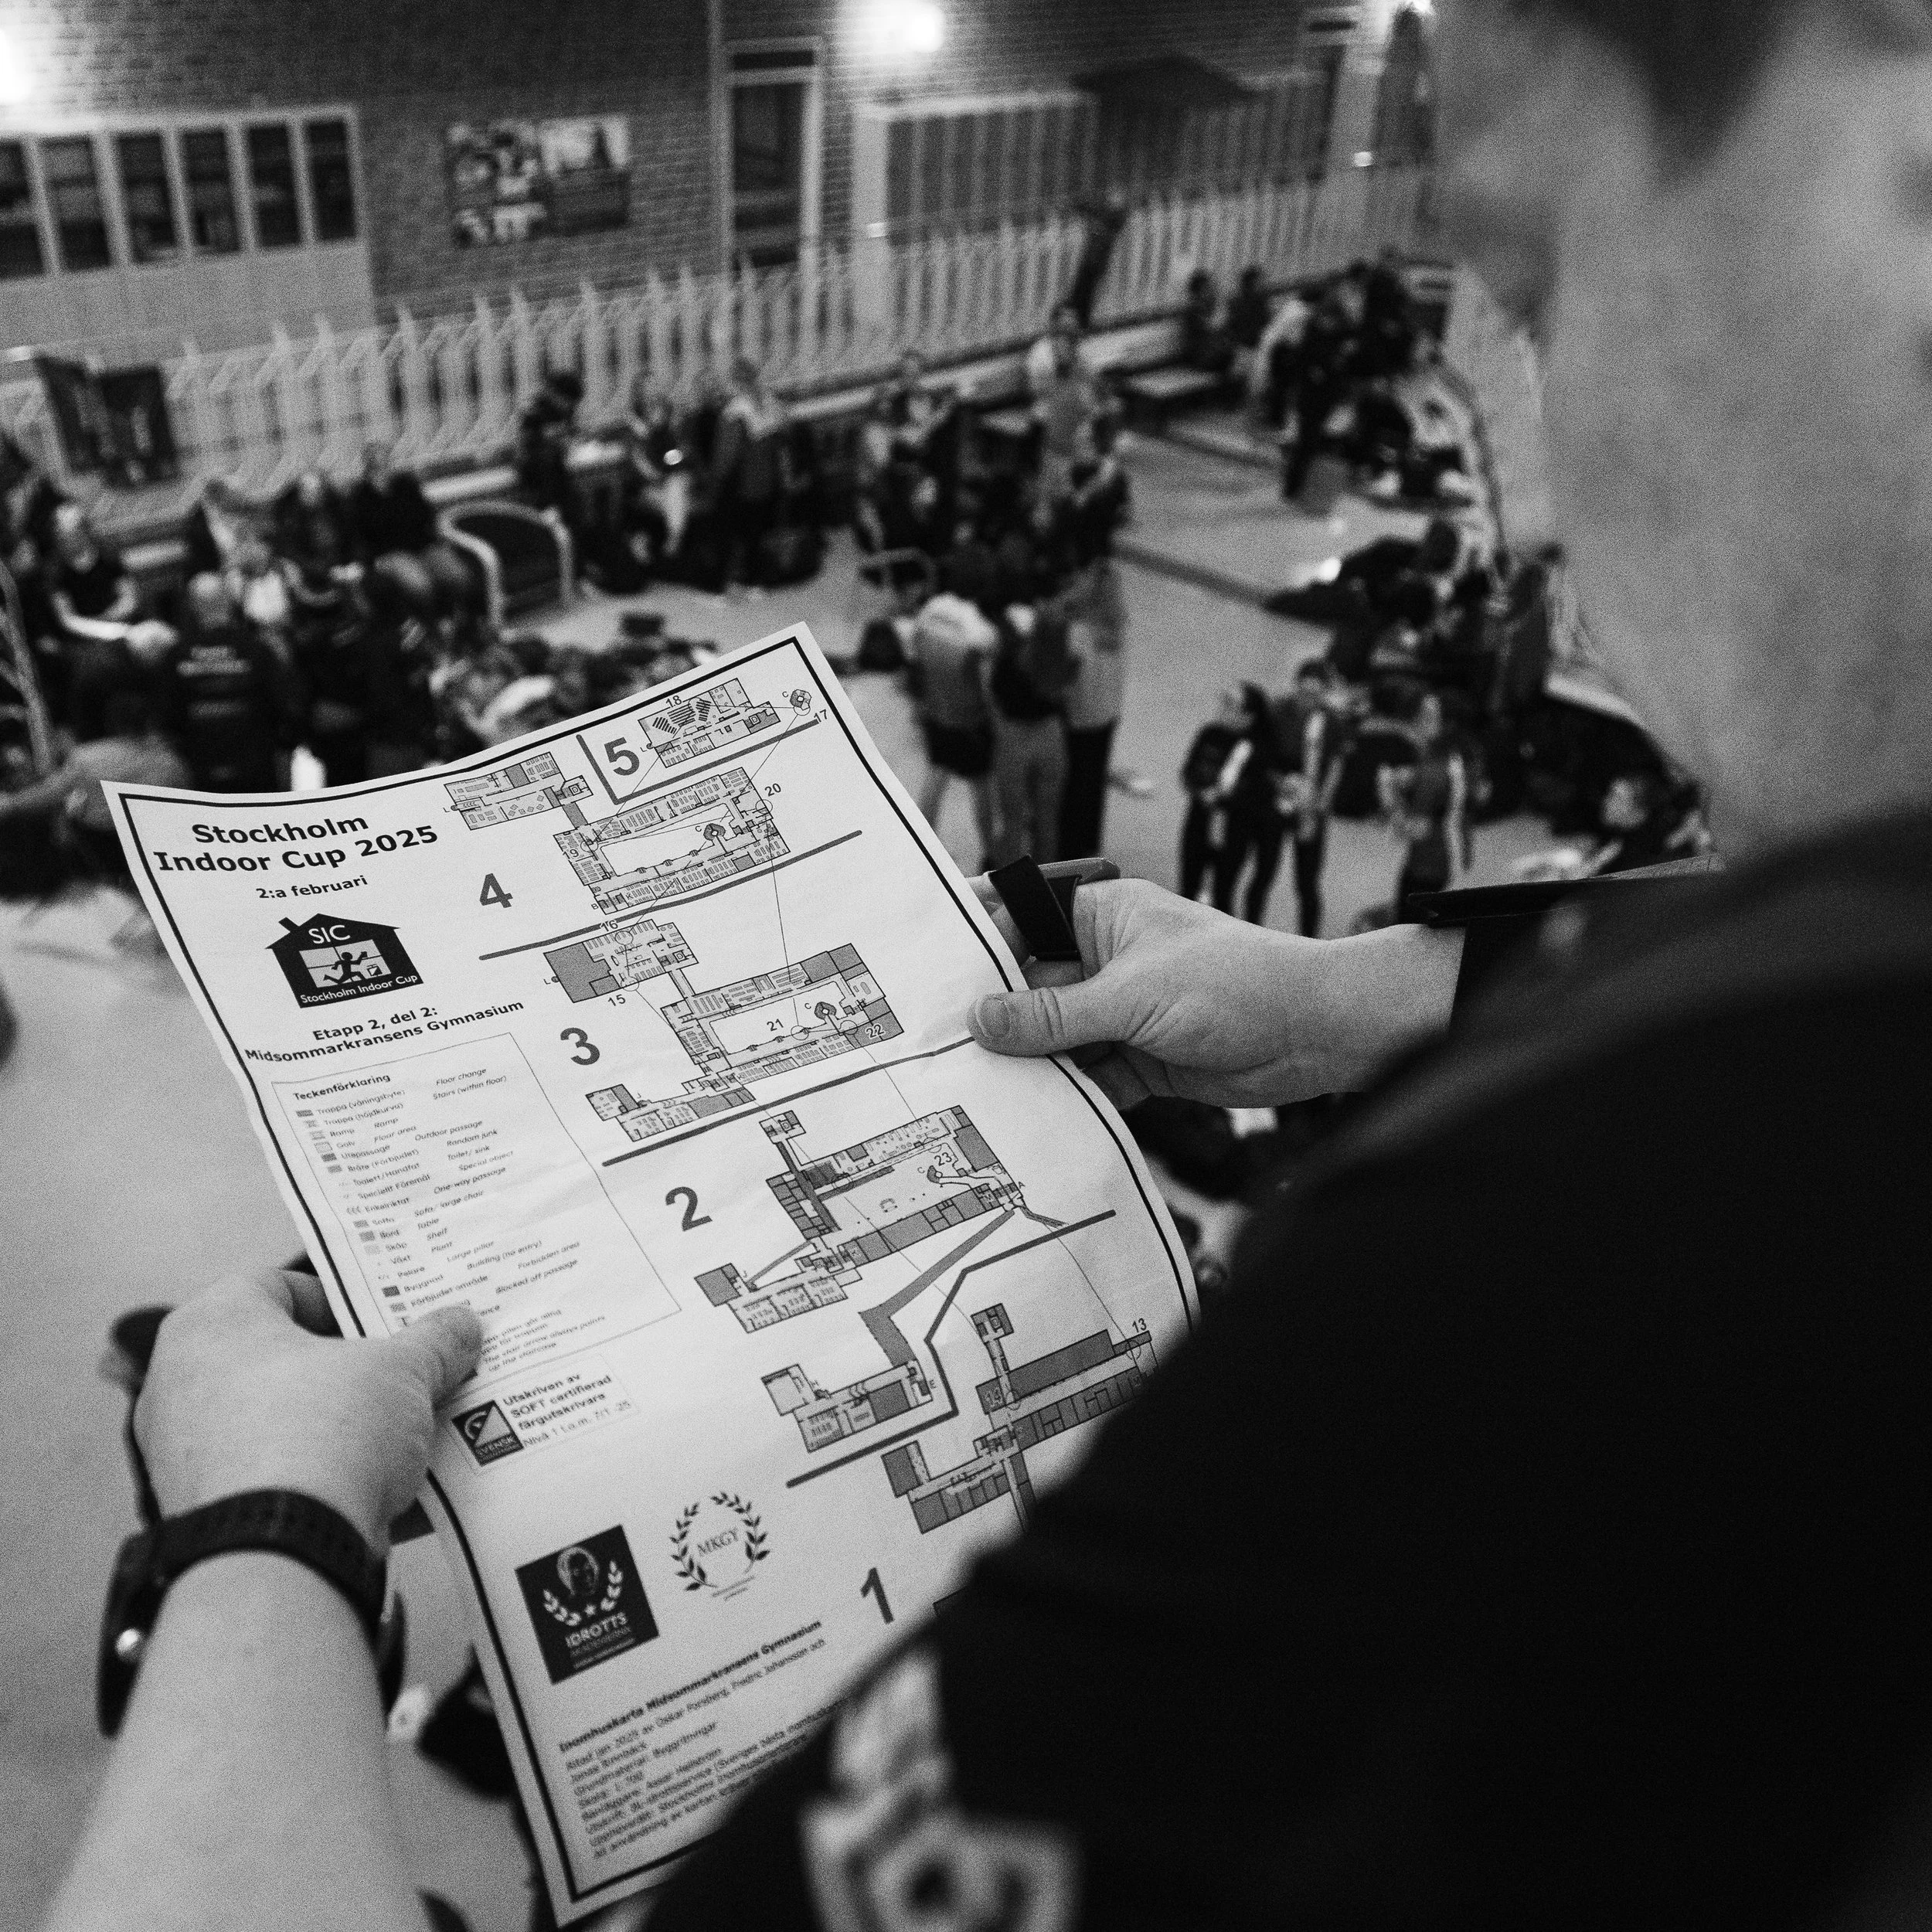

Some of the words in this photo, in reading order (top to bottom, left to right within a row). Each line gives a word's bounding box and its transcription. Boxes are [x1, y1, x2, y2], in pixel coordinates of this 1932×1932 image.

[665, 696, 682, 709] 18
[813, 709, 830, 723] 17
[604, 736, 640, 776] 5
[764, 783, 782, 797] 20
[192, 816, 369, 844] Stockholm
[154, 851, 270, 872] Indoor
[281, 849, 346, 869] Cup
[355, 825, 438, 858] 2025
[563, 849, 580, 861] 19
[256, 888, 287, 900] 2:a
[291, 875, 369, 896] februari
[479, 872, 513, 909] 4
[308, 924, 351, 944] SIC
[600, 920, 619, 932] 16
[300, 985, 356, 1003] Stockholm
[358, 980, 393, 994] Indoor
[396, 975, 419, 986] Cup
[607, 994, 626, 1007] 15
[244, 1026, 423, 1063] Midsommarkransens
[427, 1002, 525, 1032] Gymnasium
[313, 1022, 364, 1041] Etapp
[368, 1019, 386, 1030] 2,
[389, 1011, 417, 1026] del
[420, 1006, 438, 1018] 2:
[766, 1018, 784, 1032] 21
[866, 1024, 885, 1038] 22
[560, 1027, 600, 1066] 3
[458, 1069, 486, 1080] change
[294, 1075, 390, 1100] Teckenförklaring
[433, 1090, 455, 1100] Stairs
[450, 1121, 482, 1134] passage
[934, 1151, 952, 1165] 23
[665, 1186, 713, 1231] 2
[1132, 1318, 1148, 1333] 13
[503, 1381, 563, 1406] Utskriven
[511, 1400, 544, 1418] SOFT
[550, 1376, 611, 1403] certifierad
[697, 1527, 740, 1556] MKGY
[860, 1567, 893, 1624] 1
[566, 1612, 627, 1647] IDROTTS
